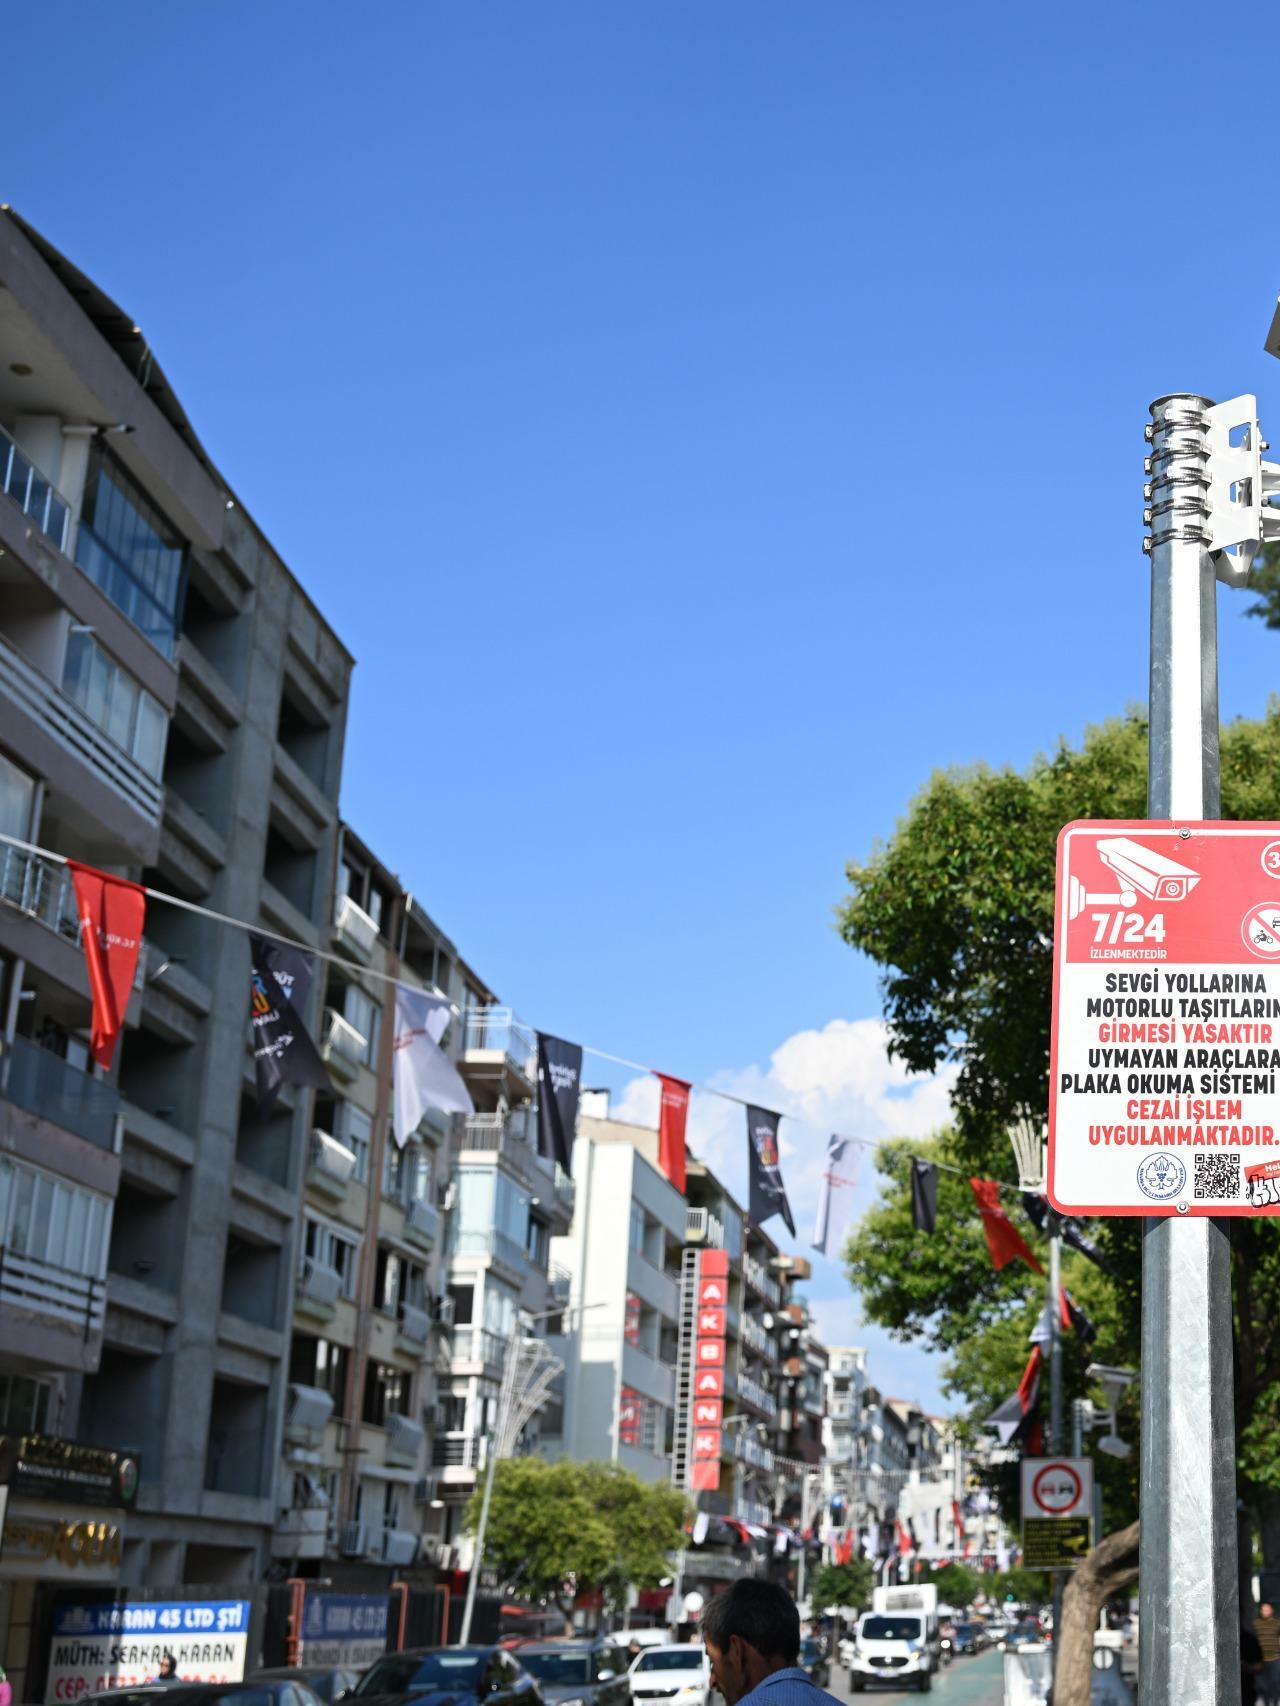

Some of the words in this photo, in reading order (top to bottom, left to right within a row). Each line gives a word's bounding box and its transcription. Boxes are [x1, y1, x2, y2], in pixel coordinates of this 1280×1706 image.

[1091, 911, 1167, 945] 7/24
[1090, 946, 1168, 960] İZLENMEKTEDİR
[1105, 967, 1159, 993] SEVGİ
[1165, 973, 1268, 994] YOLLARINA
[1086, 998, 1174, 1019] MOTORLU
[1098, 1018, 1177, 1044] GİRMESİ
[1183, 1023, 1273, 1044] YASAKTIR
[1088, 1048, 1179, 1069] UYMAYAN
[1060, 1073, 1122, 1094] PLAKA
[1127, 1074, 1195, 1094] OKUMA
[1200, 1068, 1275, 1095] SİSTEMİ
[1126, 1094, 1180, 1120] CEZAİ
[1186, 1094, 1243, 1124] İŞLEM
[1088, 1125, 1280, 1146] UYGULANMAKTADIR.
[696, 1284, 721, 1450] AKBANK
[97, 1609, 156, 1629] KARAN
[158, 1608, 181, 1628] 45
[184, 1608, 215, 1628] LTD
[217, 1604, 243, 1631] ŞTİ
[179, 1644, 236, 1663] KARAN
